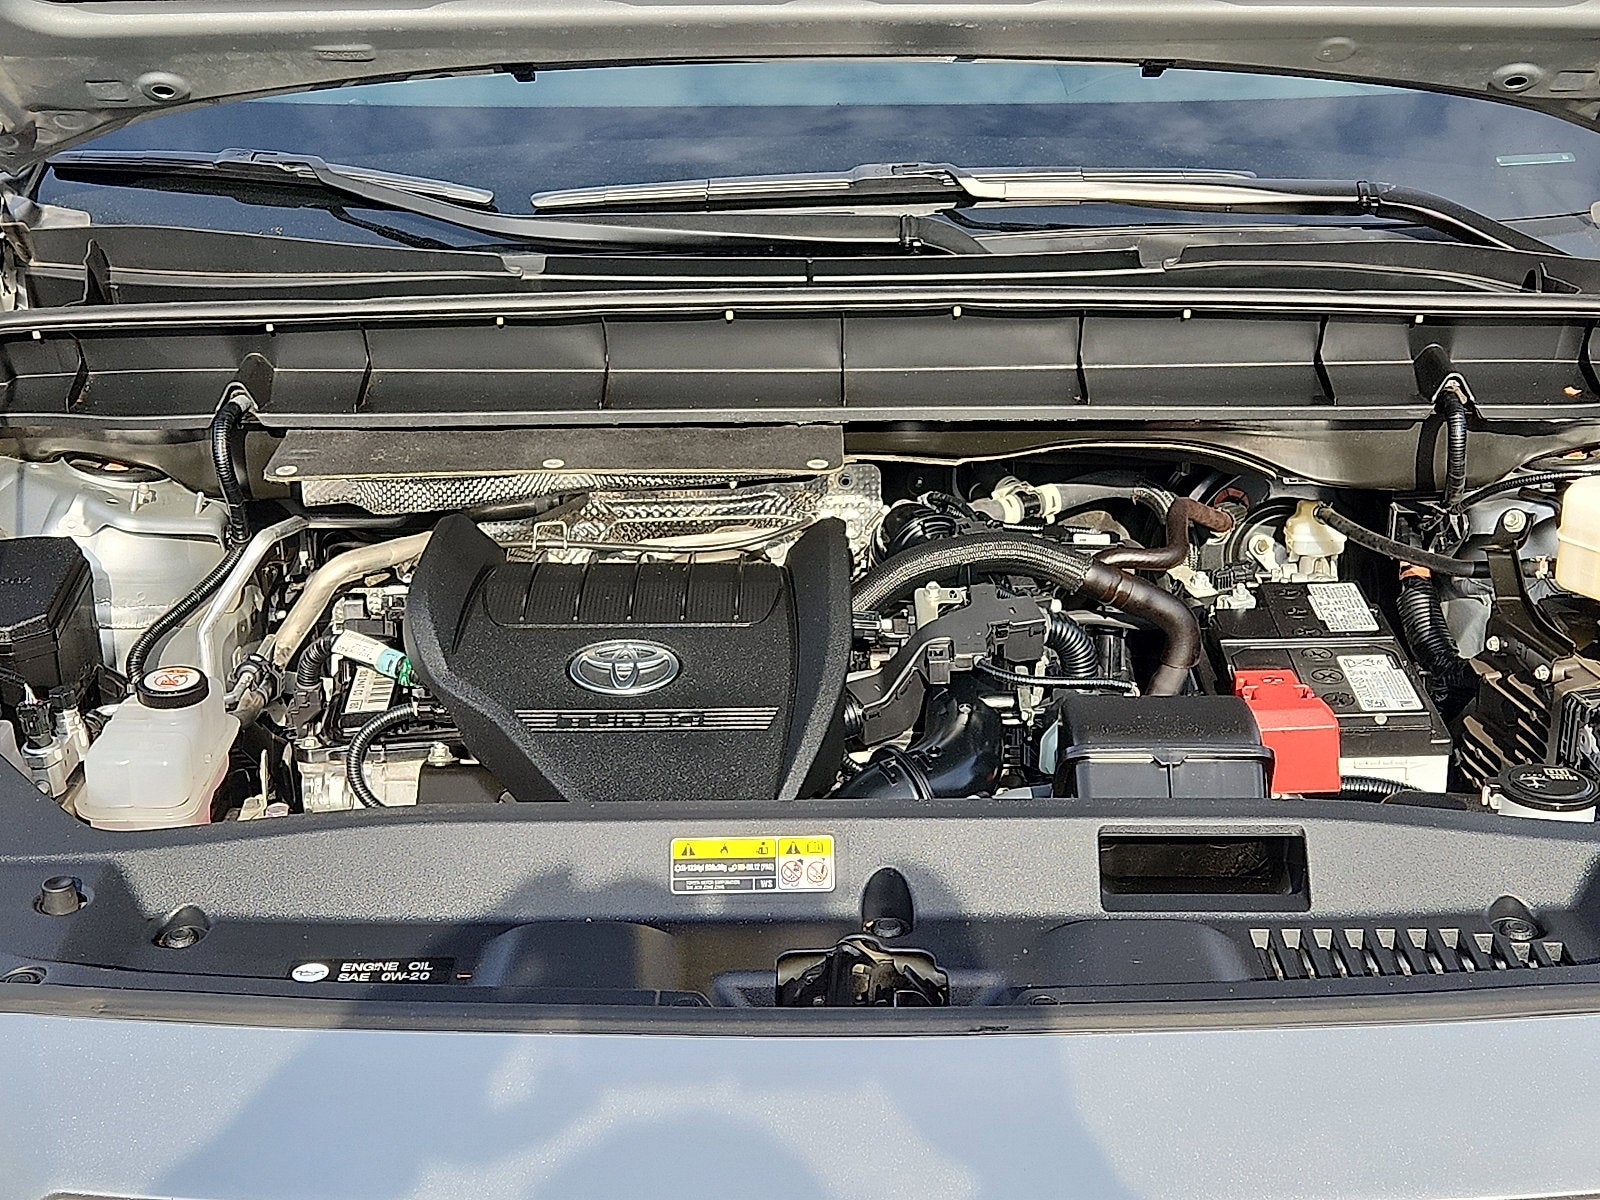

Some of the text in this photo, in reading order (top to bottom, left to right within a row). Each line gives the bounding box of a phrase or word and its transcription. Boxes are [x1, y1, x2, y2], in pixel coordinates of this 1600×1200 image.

[340, 961, 434, 972] ENGINE OIL
[337, 972, 431, 982] SAE 0W-20
